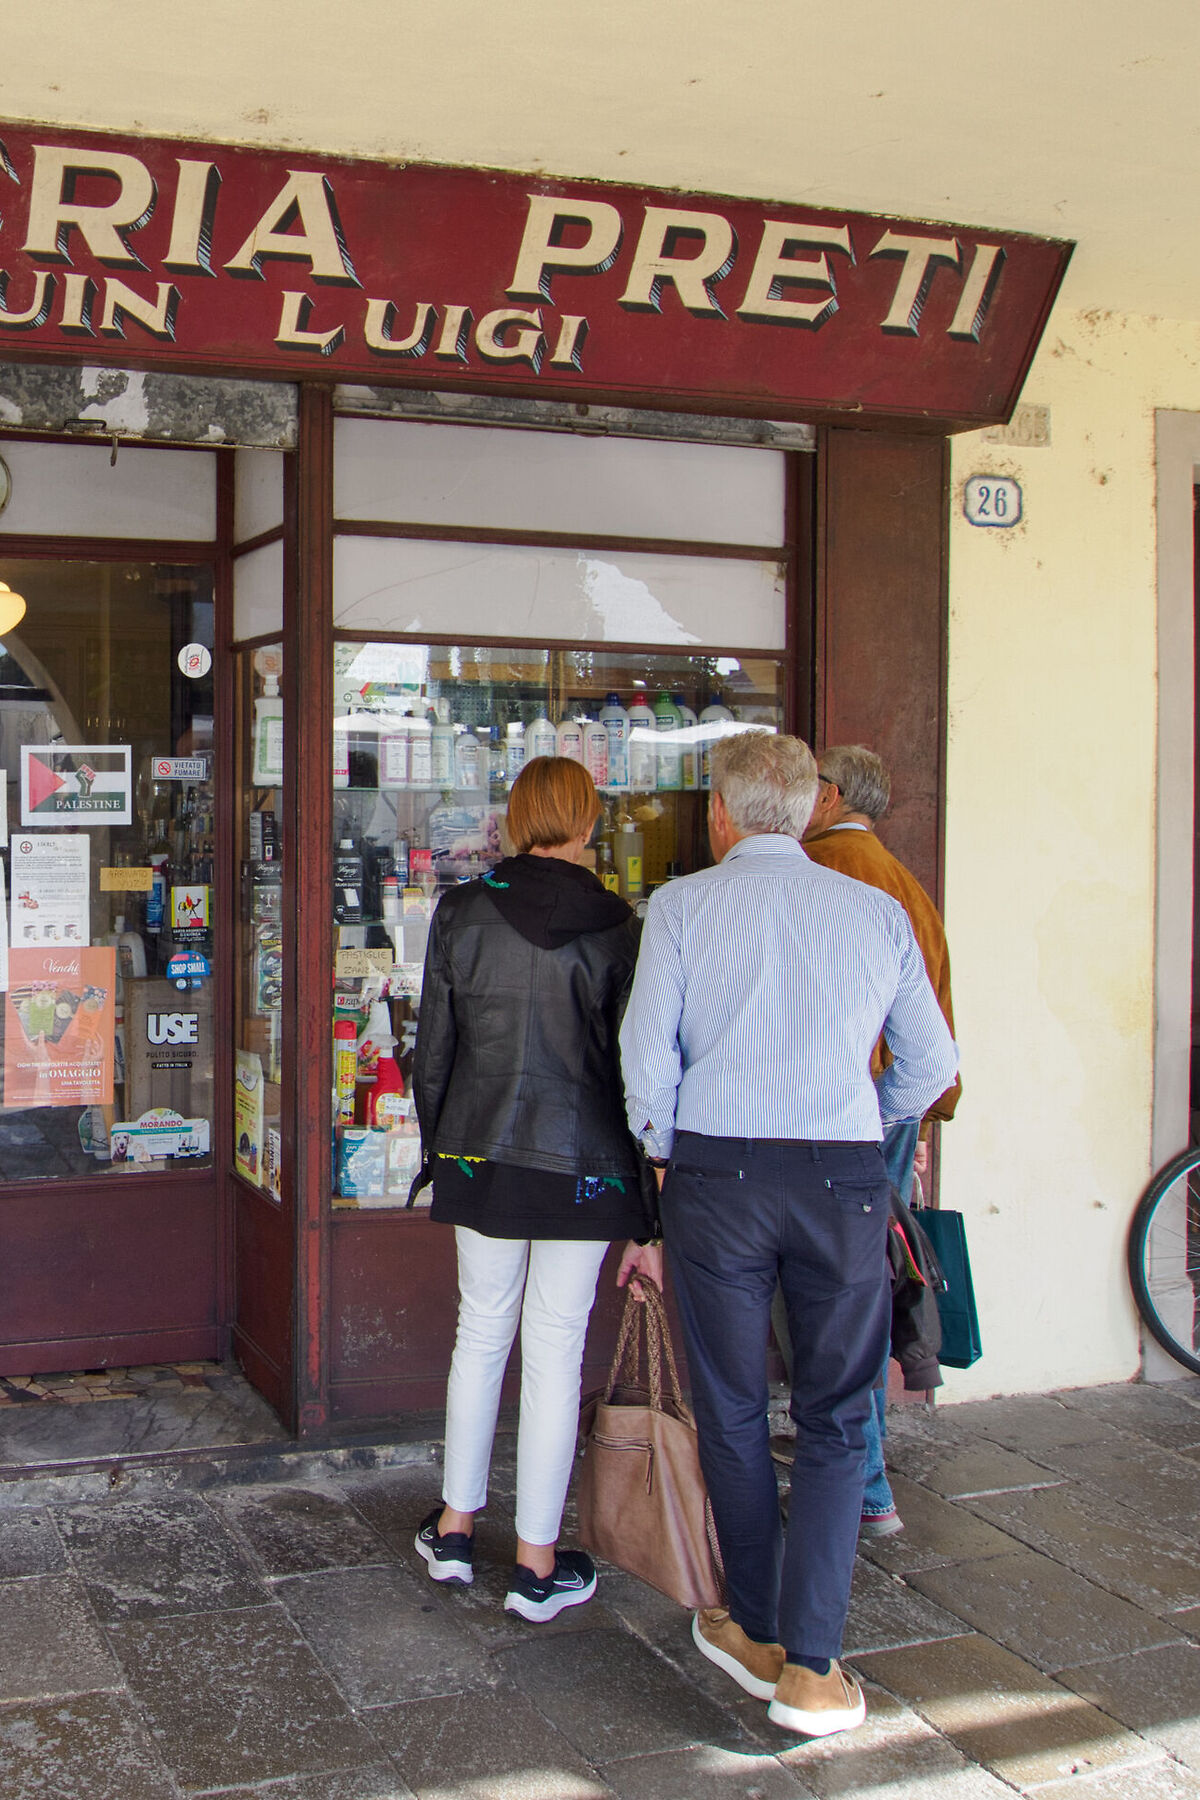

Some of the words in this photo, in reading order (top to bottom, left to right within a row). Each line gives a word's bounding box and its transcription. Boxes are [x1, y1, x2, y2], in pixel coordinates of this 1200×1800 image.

[504, 194, 1006, 342] PRETI
[273, 290, 589, 375] LUIGI
[978, 486, 1007, 517] 26
[174, 761, 201, 769] VIETATO
[174, 769, 201, 777] FUMARE
[55, 799, 121, 810] PALESTINE
[171, 963, 187, 975] SHOP
[146, 1012, 199, 1045] USE
[39, 1071, 47, 1079] in
[49, 1069, 101, 1078] OMAGGIO
[140, 1120, 183, 1128] MORANDO
